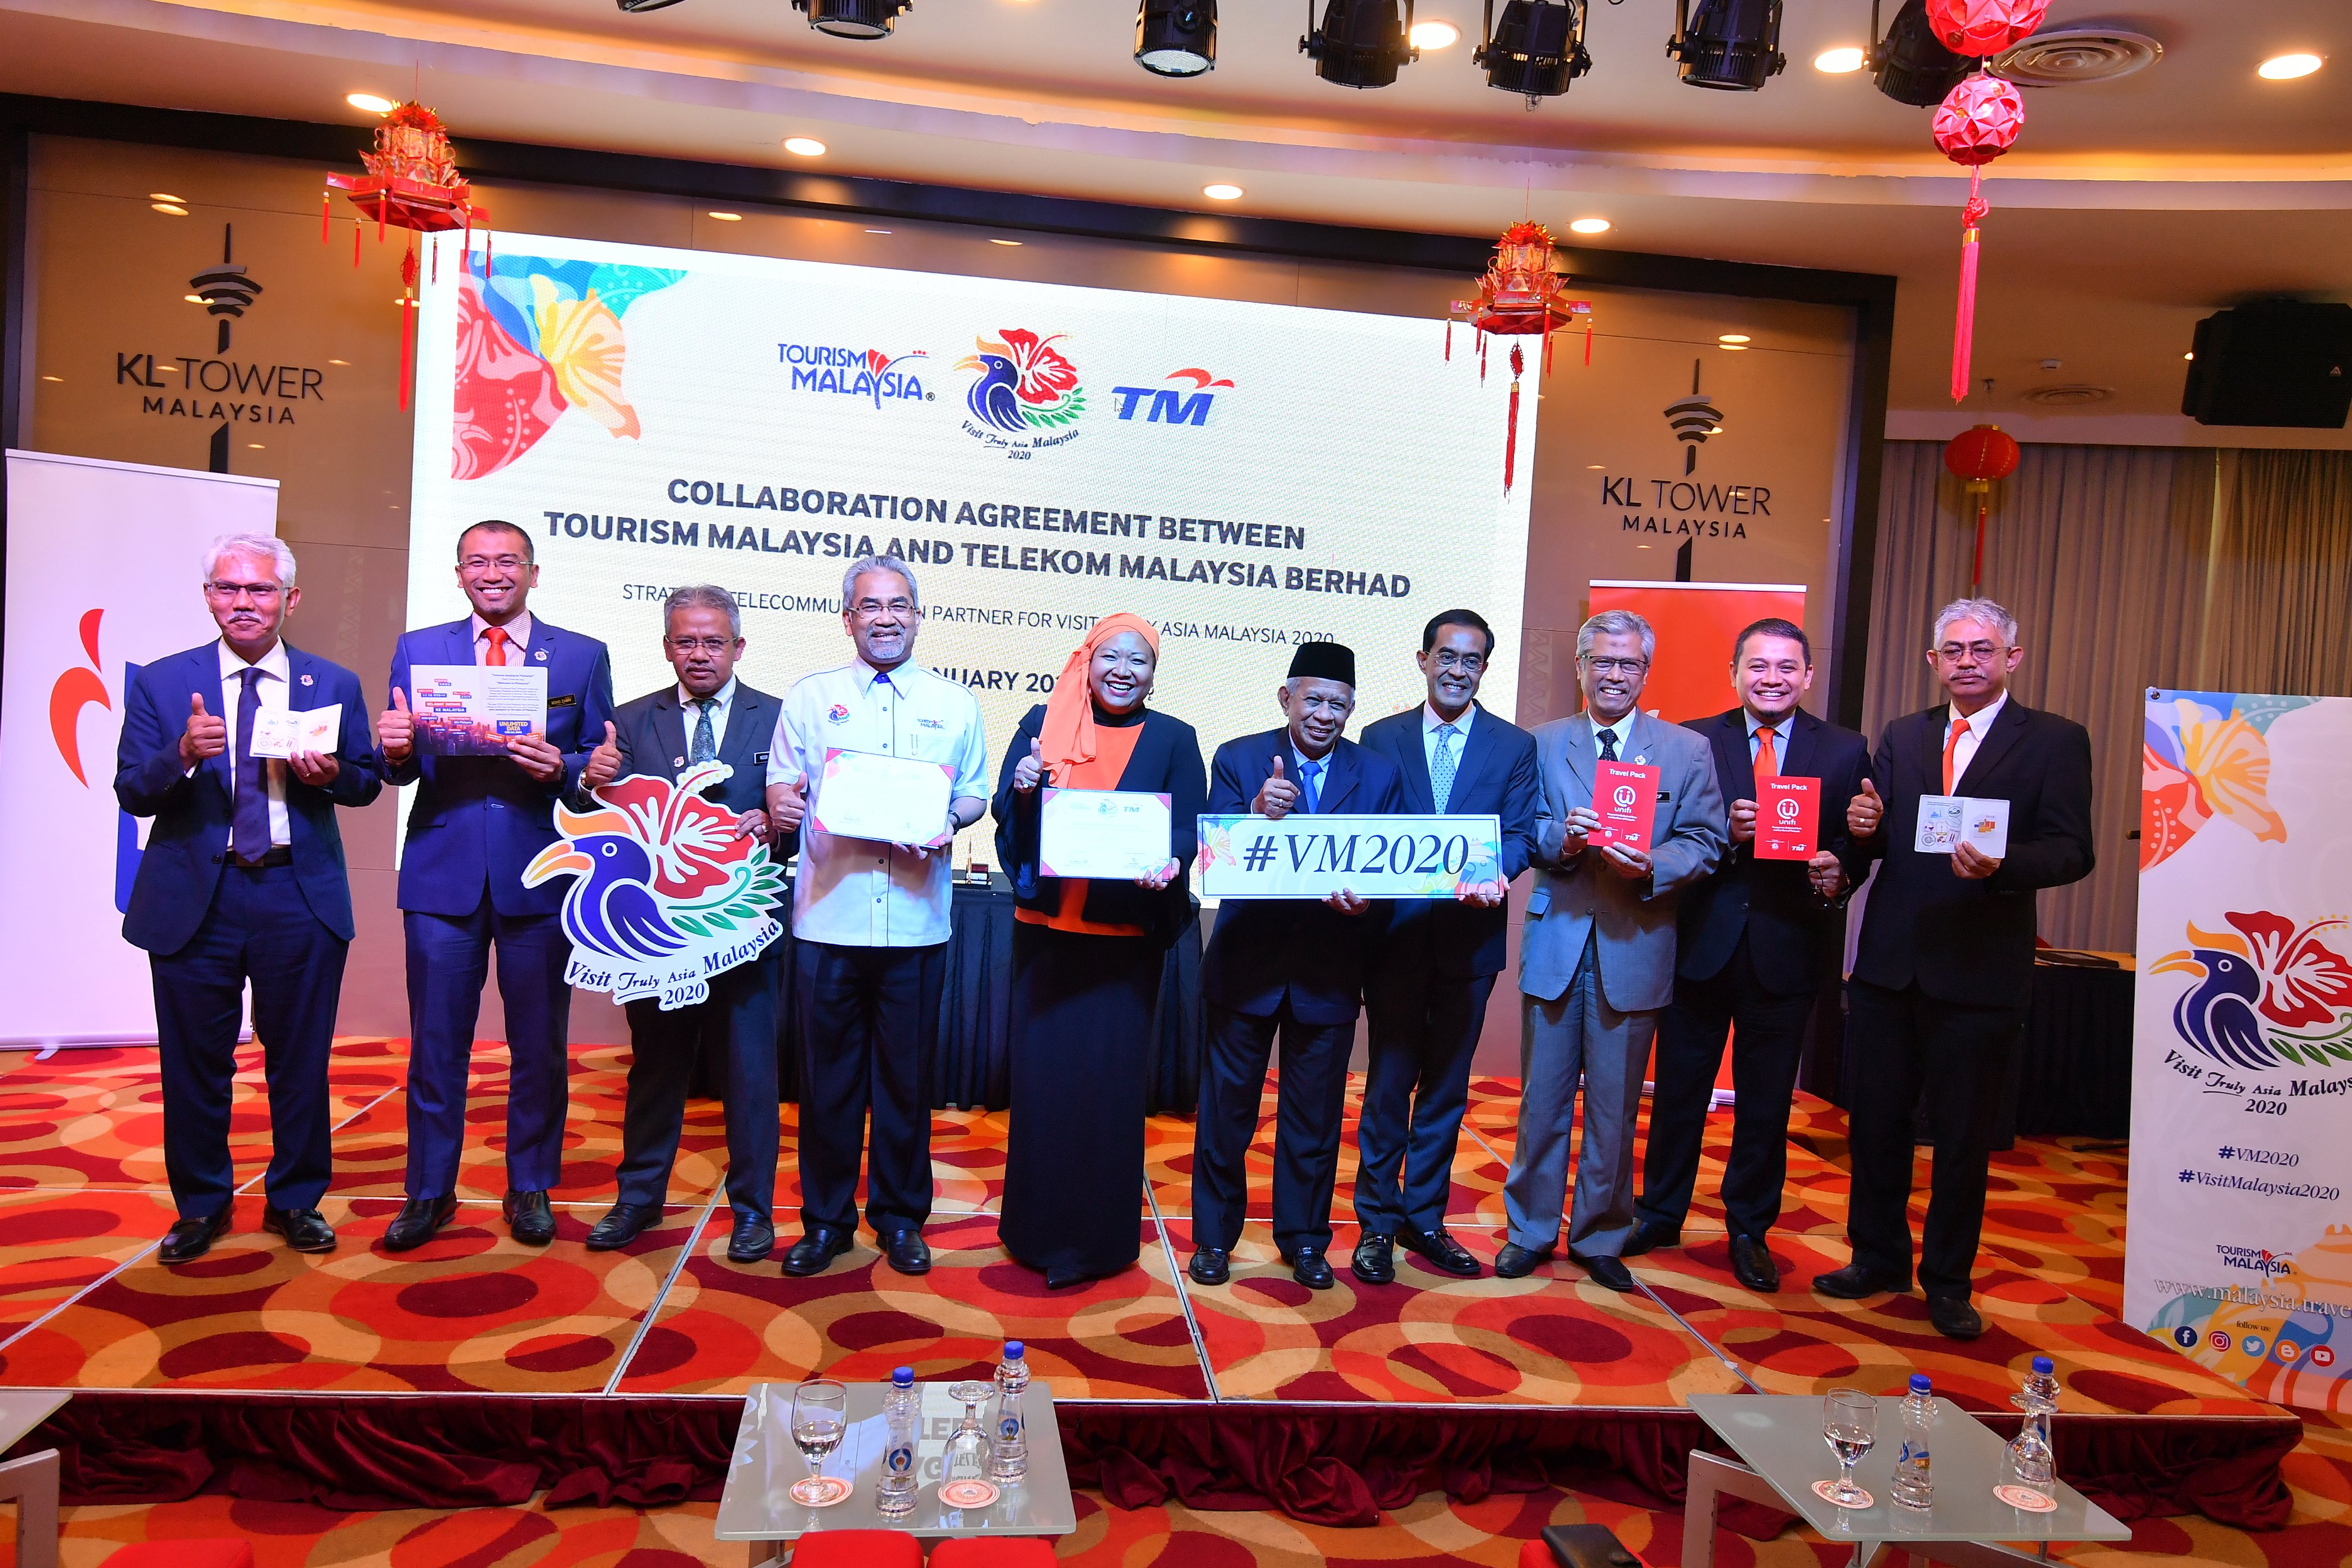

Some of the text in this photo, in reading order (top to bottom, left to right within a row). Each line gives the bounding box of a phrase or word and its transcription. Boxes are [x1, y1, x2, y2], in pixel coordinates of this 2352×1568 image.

[778, 344, 866, 369] TOURISM
[117, 352, 324, 402] KL TOWER
[792, 366, 922, 409] MALAYSIA
[142, 395, 295, 424] MALAYSIA
[1111, 386, 1214, 426] TM
[961, 420, 984, 439] Visit
[1032, 429, 1080, 448] Malaysia
[1007, 450, 1031, 460] 2020
[1602, 475, 1771, 516] KL TOWER
[667, 478, 1305, 550] COLLABORATION AGREEMENT BETWEEN
[1623, 515, 1747, 539] MALAYSIA
[544, 511, 1411, 598] TOURISM MALAYSIA AND TELEKOM MALAYSIA BERHAD
[933, 605, 1013, 626] PARTNER
[1018, 611, 1052, 629] FOR
[1161, 621, 1200, 638] ASIA
[1204, 623, 1287, 644] MALAYSIA
[1609, 768, 1646, 779] Travel Pack
[1243, 834, 1469, 875] #VM2020
[568, 918, 779, 992] Visit Truly Asia Malaysia
[664, 982, 705, 1006] 2020
[2163, 1049, 2203, 1080] Visit
[2204, 1071, 2246, 1095] Truly
[2252, 1084, 2282, 1096] Asia
[2244, 1098, 2287, 1116] 2020
[2218, 1145, 2300, 1167] #VM2020
[2178, 1169, 2340, 1201] #VisitMalaysia2020
[2216, 1244, 2261, 1259] TOURISM
[2224, 1255, 2291, 1278] MALAYSIA
[2154, 1279, 2352, 1318] www.malaysia.trave
[2236, 1320, 2271, 1332] follow us:
